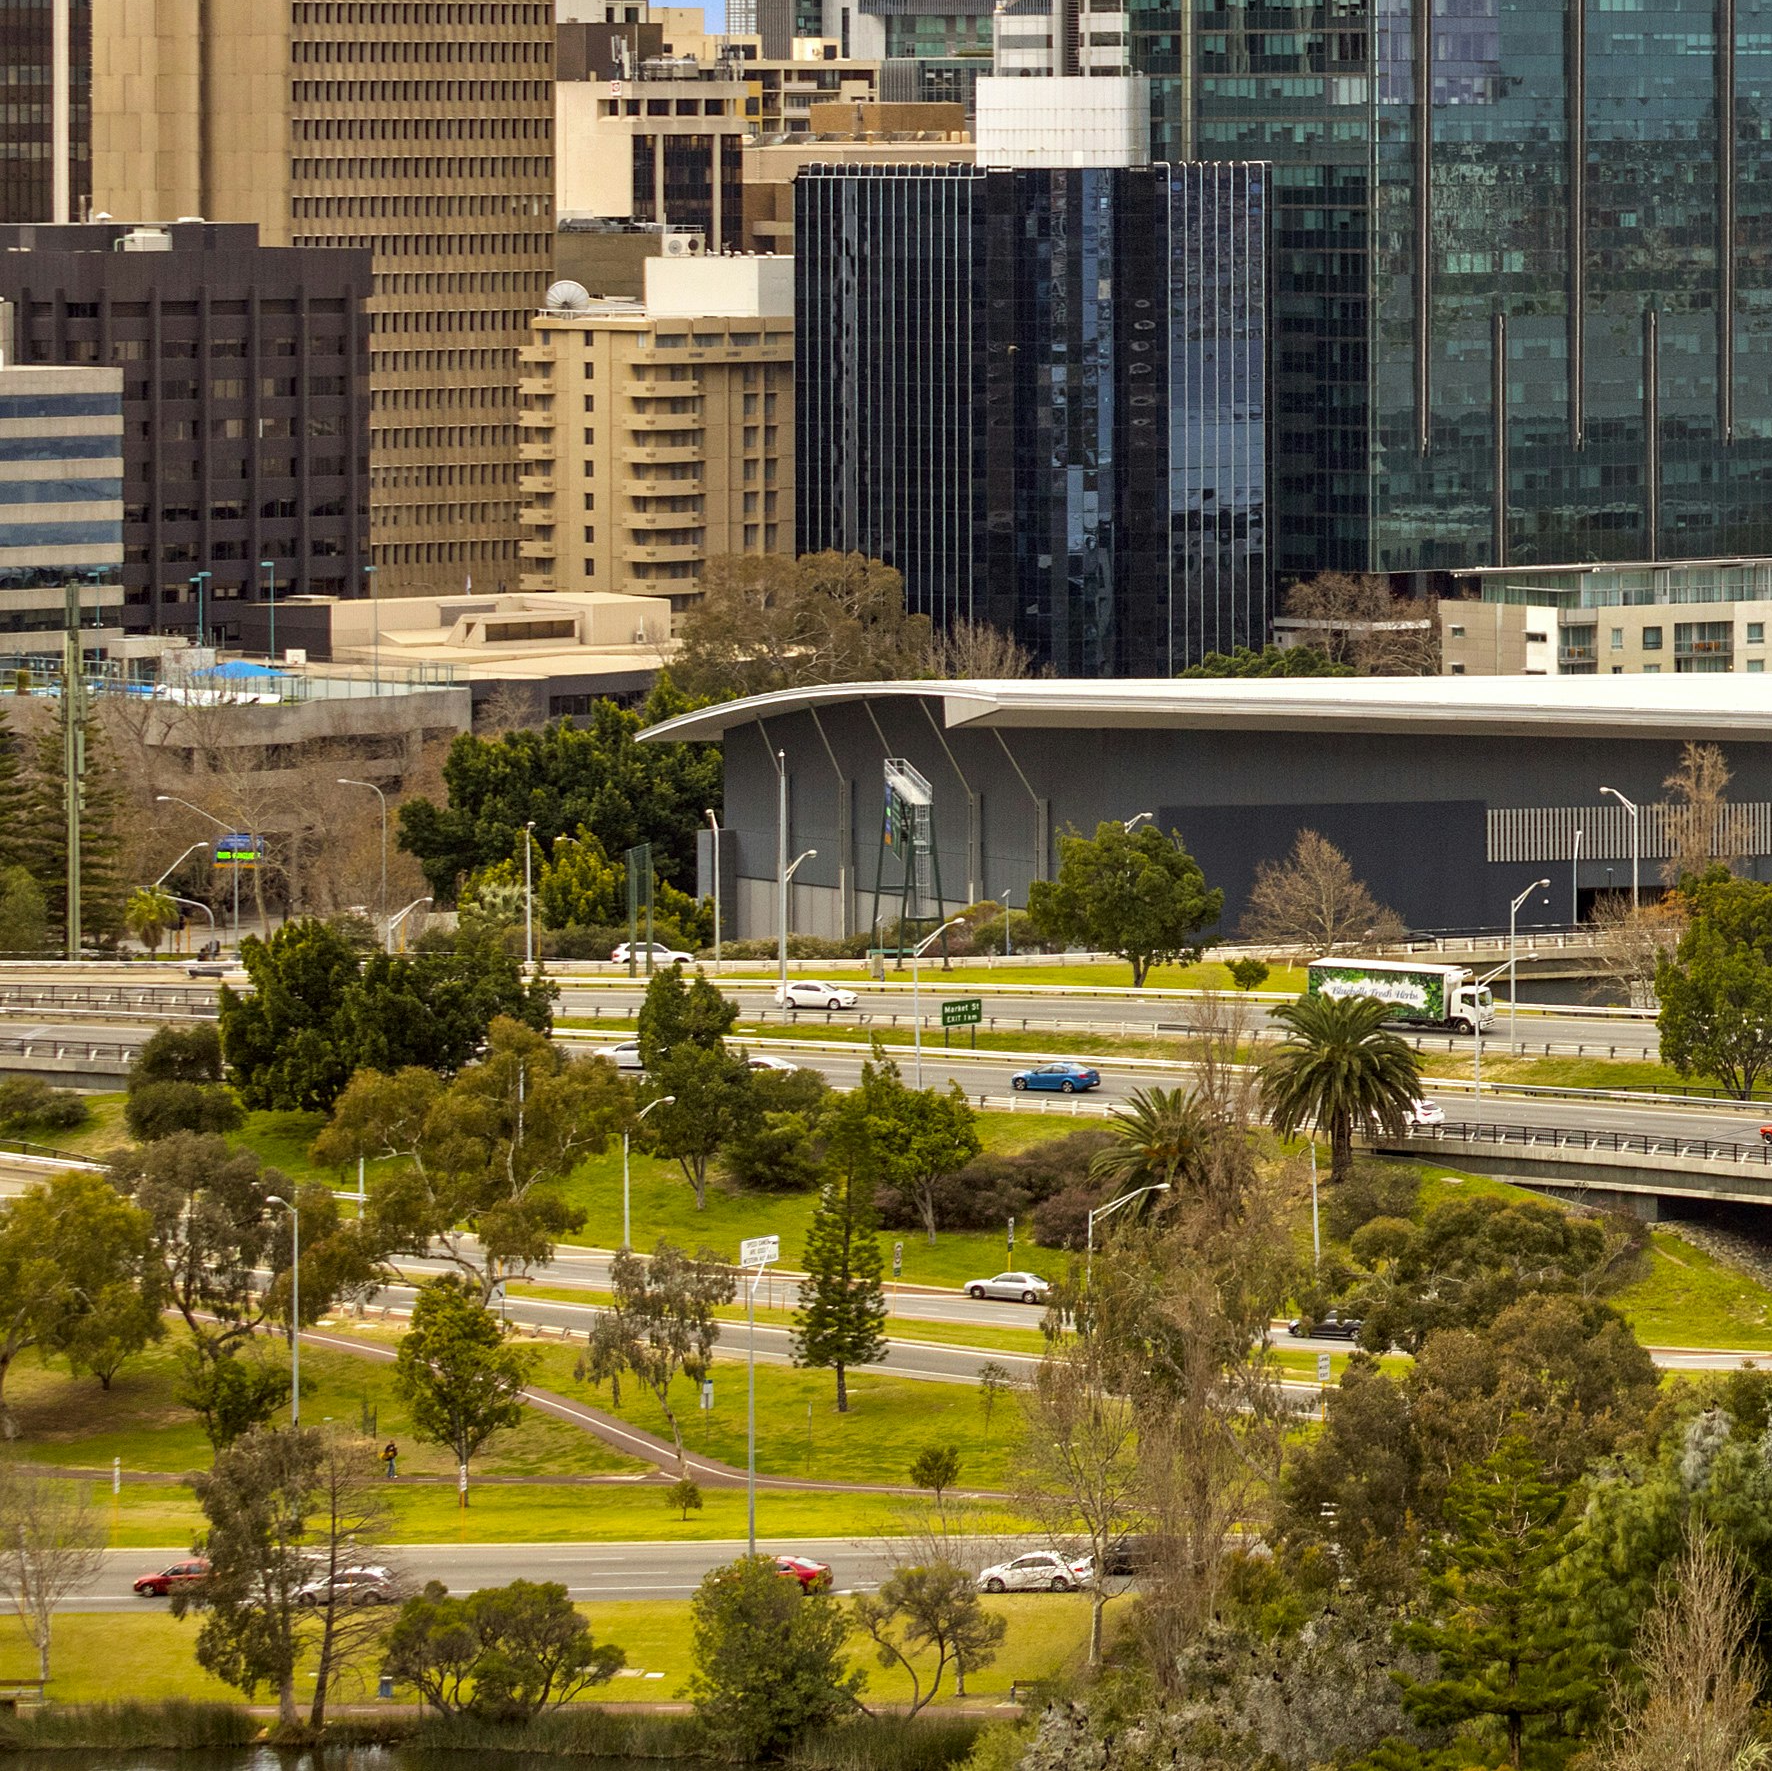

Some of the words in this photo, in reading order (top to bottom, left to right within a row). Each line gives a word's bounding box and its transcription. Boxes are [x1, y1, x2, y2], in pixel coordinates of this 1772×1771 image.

[1369, 988, 1392, 998] Fresh
[1395, 990, 1419, 1000] Herbs
[944, 1004, 968, 1013] Market
[971, 1003, 980, 1011] St
[946, 1015, 961, 1023] EXIT
